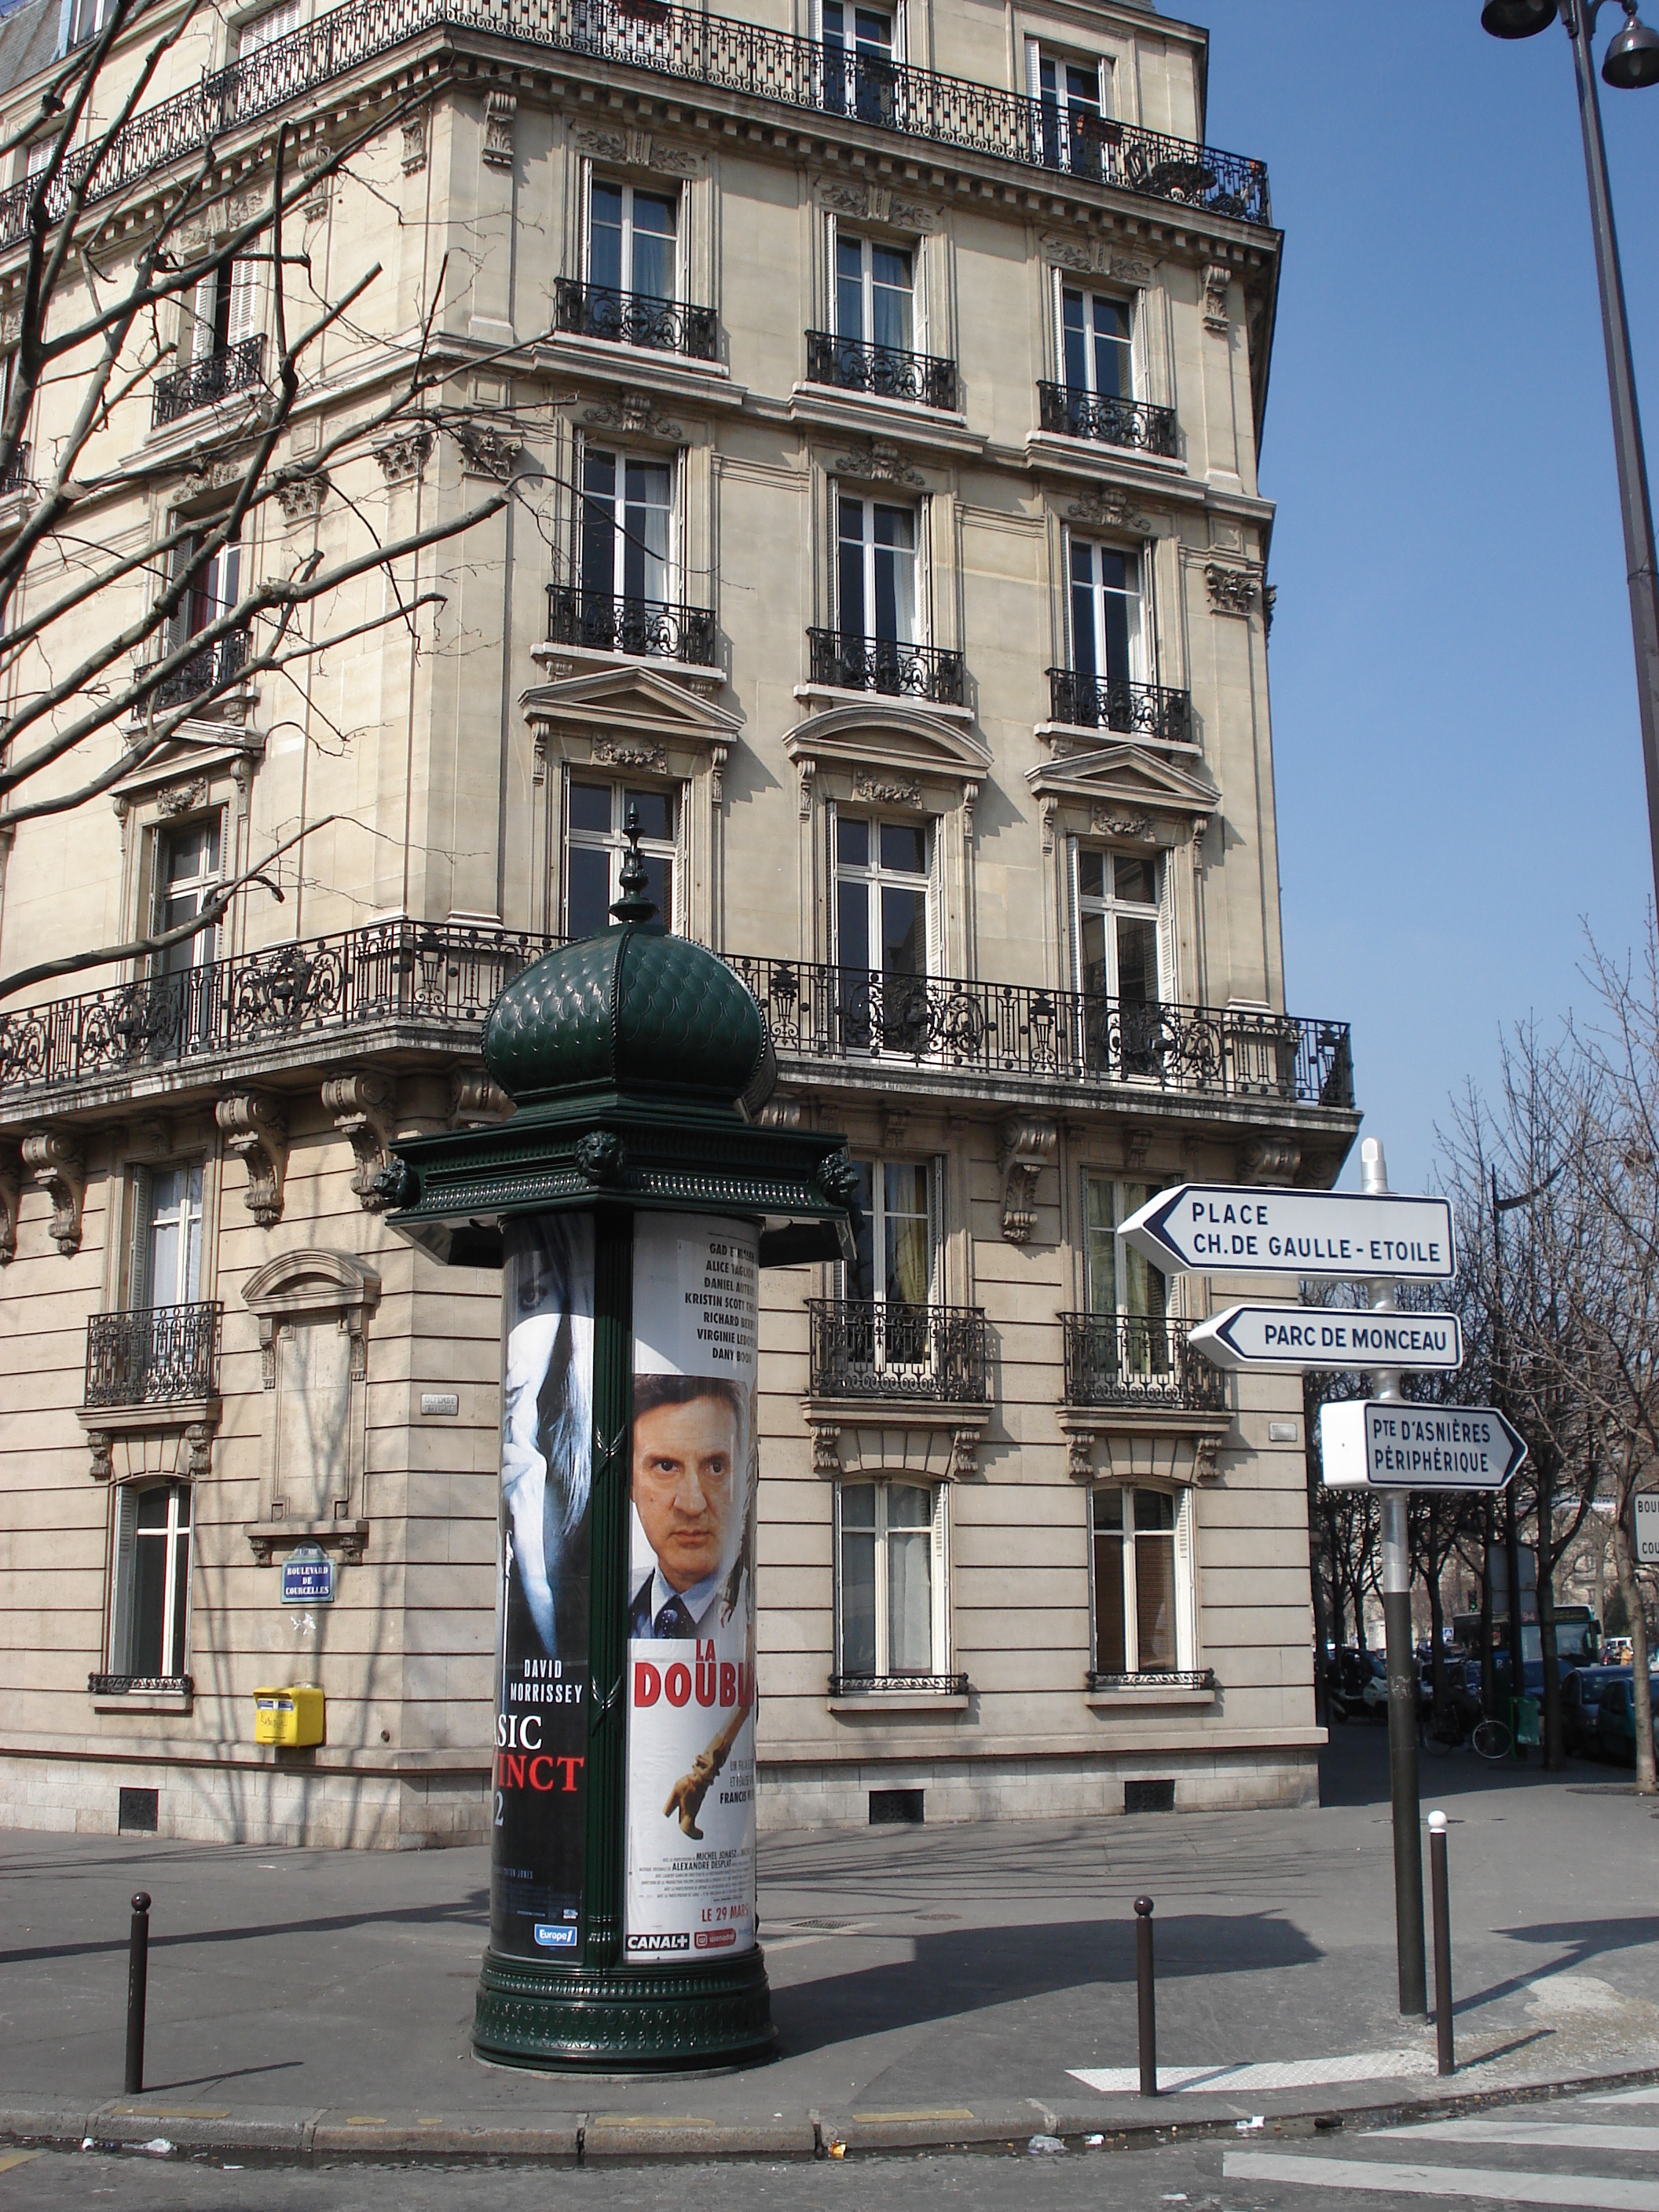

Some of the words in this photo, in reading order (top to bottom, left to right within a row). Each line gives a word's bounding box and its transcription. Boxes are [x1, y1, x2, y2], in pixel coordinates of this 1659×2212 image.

[1192, 1202, 1269, 1225] PLACE
[709, 1243, 727, 1256] GAD
[706, 1260, 729, 1273] ALICE
[704, 1276, 734, 1291] DANIEL
[685, 1292, 723, 1307] KRISTIN
[725, 1297, 745, 1311] SCOTT
[704, 1311, 739, 1327] RICHARD
[697, 1328, 735, 1344] VIRGINIE
[1265, 1324, 1316, 1346] PARC
[1321, 1327, 1346, 1347] DE
[1352, 1328, 1446, 1350] MONCEAU
[712, 1347, 734, 1361] DANY
[1375, 1445, 1489, 1473] PÉRIPHÉRIQUE
[1638, 1500, 1659, 1513] BOU
[287, 1566, 328, 1576] BOULEVARD
[302, 1577, 313, 1585] DE
[285, 1586, 329, 1595] COURCELLES
[696, 1639, 716, 1661] LA
[524, 1659, 562, 1679] DAVID
[510, 1683, 583, 1704] MORRISSEY
[495, 1713, 542, 1750] SIC
[720, 1791, 746, 1804] FRANCIS
[494, 1791, 504, 1826] 2
[696, 1851, 717, 1861] MICHEL
[672, 1861, 709, 1871] ALEXANDRE
[711, 1859, 732, 1870] DESPLAT
[701, 1909, 712, 1922] LE
[716, 1907, 727, 1921] 29
[628, 1935, 688, 1949] CANAL+
